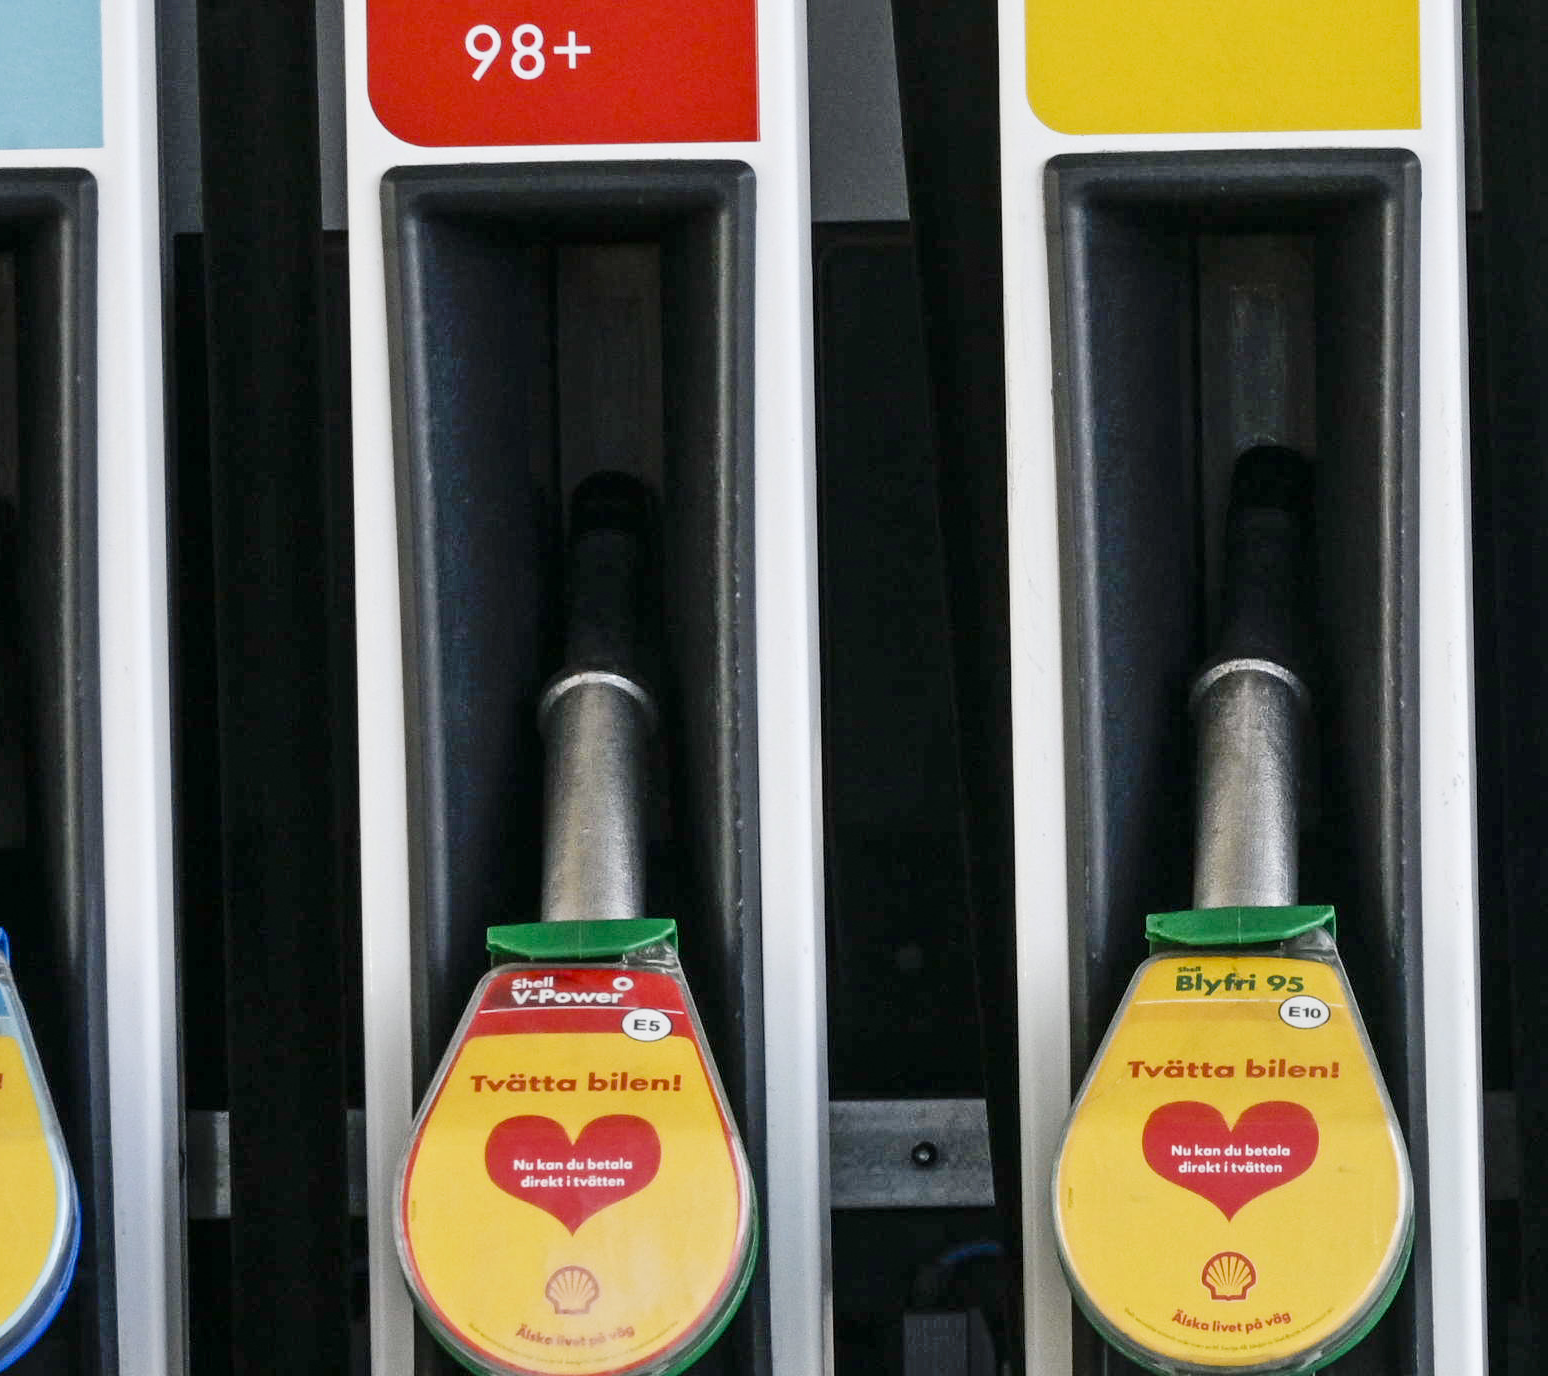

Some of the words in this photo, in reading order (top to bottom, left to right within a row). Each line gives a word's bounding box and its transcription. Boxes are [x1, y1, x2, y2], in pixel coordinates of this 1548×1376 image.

[465, 24, 591, 81] 98+
[512, 976, 553, 990] Shell
[1176, 973, 1256, 996] Blyfri
[1267, 975, 1304, 993] 95
[512, 990, 624, 1005] V-Power
[1289, 1006, 1321, 1019] E10
[633, 1019, 660, 1032] E5
[1128, 1060, 1236, 1078] Tvätta
[1246, 1059, 1339, 1078] bilen!
[470, 1074, 576, 1092] Tvätta
[588, 1072, 681, 1091] bilen!
